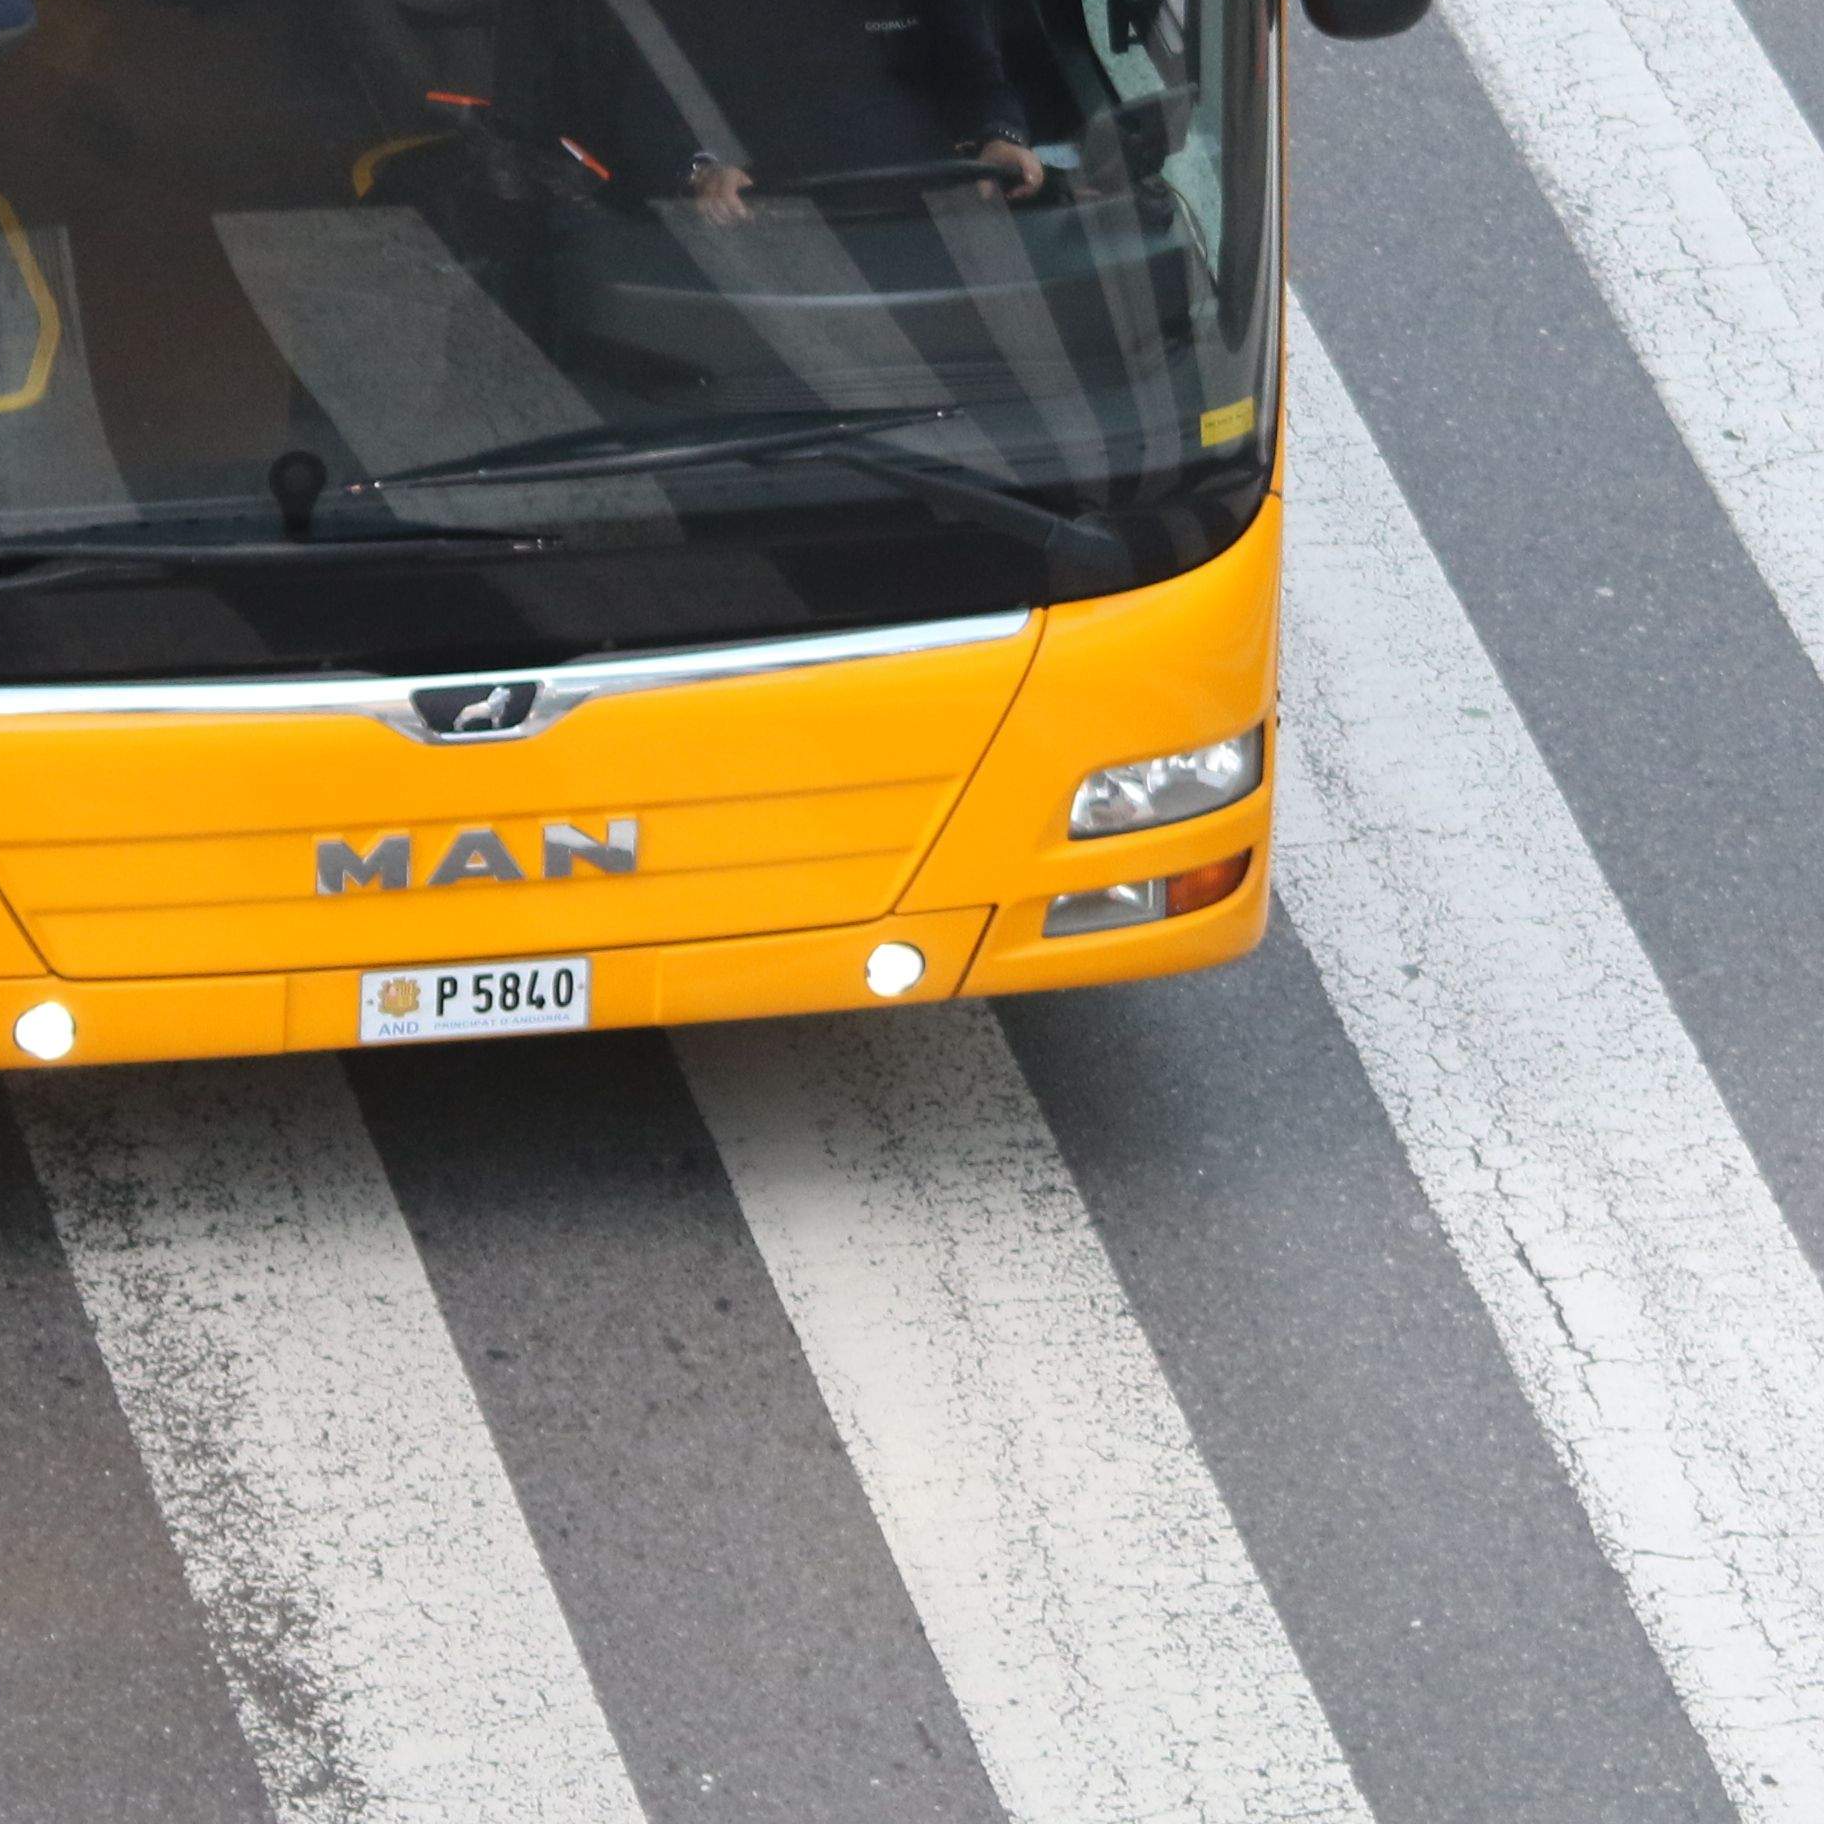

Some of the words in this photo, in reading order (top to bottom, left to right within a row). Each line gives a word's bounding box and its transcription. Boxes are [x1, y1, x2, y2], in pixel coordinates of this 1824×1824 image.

[315, 816, 638, 896] MAN
[435, 975, 459, 1017] P
[472, 967, 574, 1014] 5840
[378, 1020, 420, 1037] AND
[434, 1017, 496, 1031] PRINCIPAT
